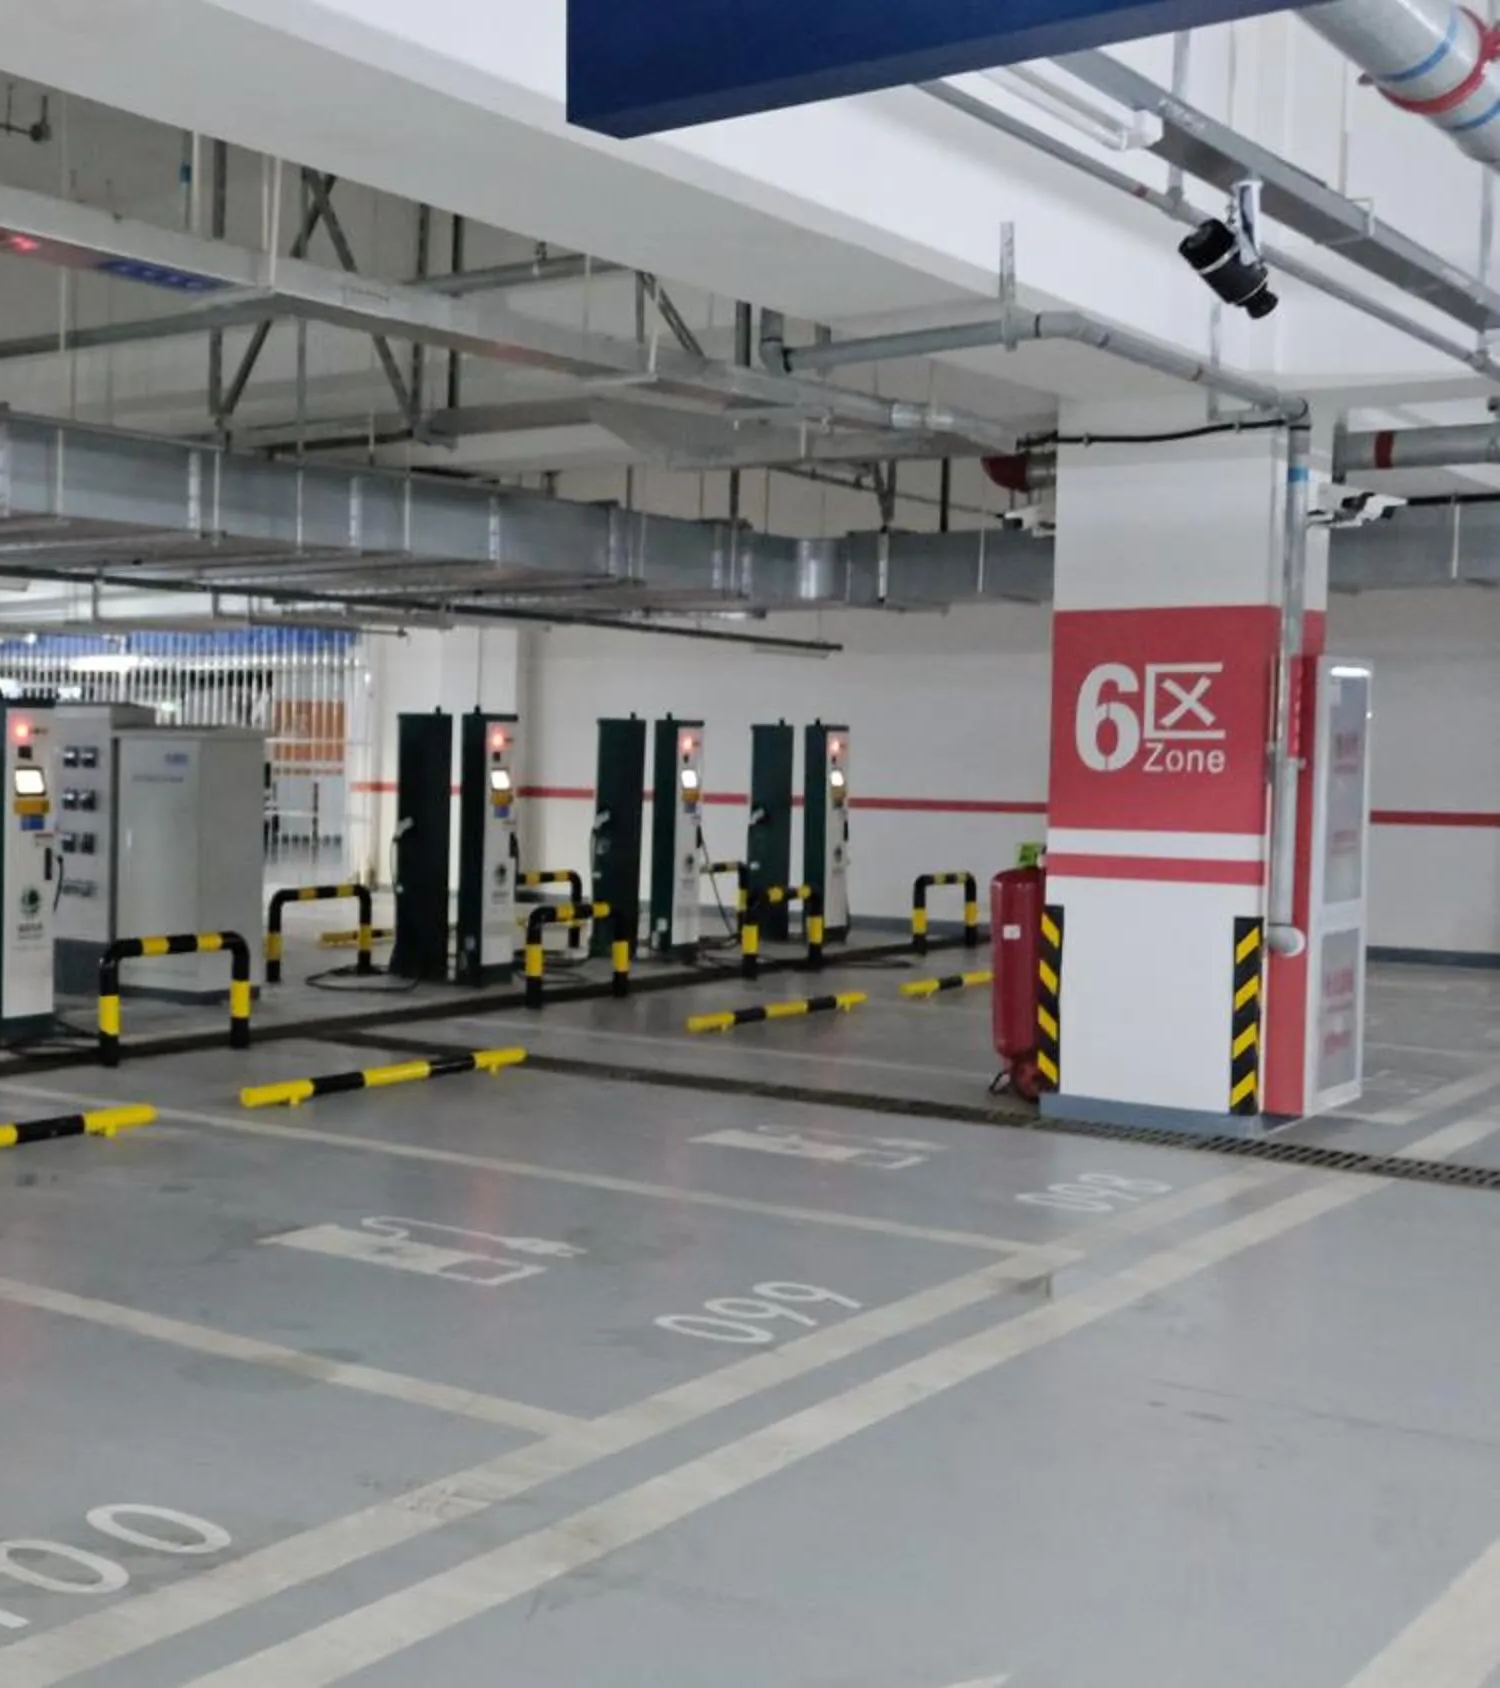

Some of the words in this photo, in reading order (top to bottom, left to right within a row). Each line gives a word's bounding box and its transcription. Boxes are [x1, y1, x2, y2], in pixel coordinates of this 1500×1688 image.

[1075, 661, 1227, 773] 6区
[1141, 741, 1227, 774] Zone
[653, 1280, 865, 1344] 099
